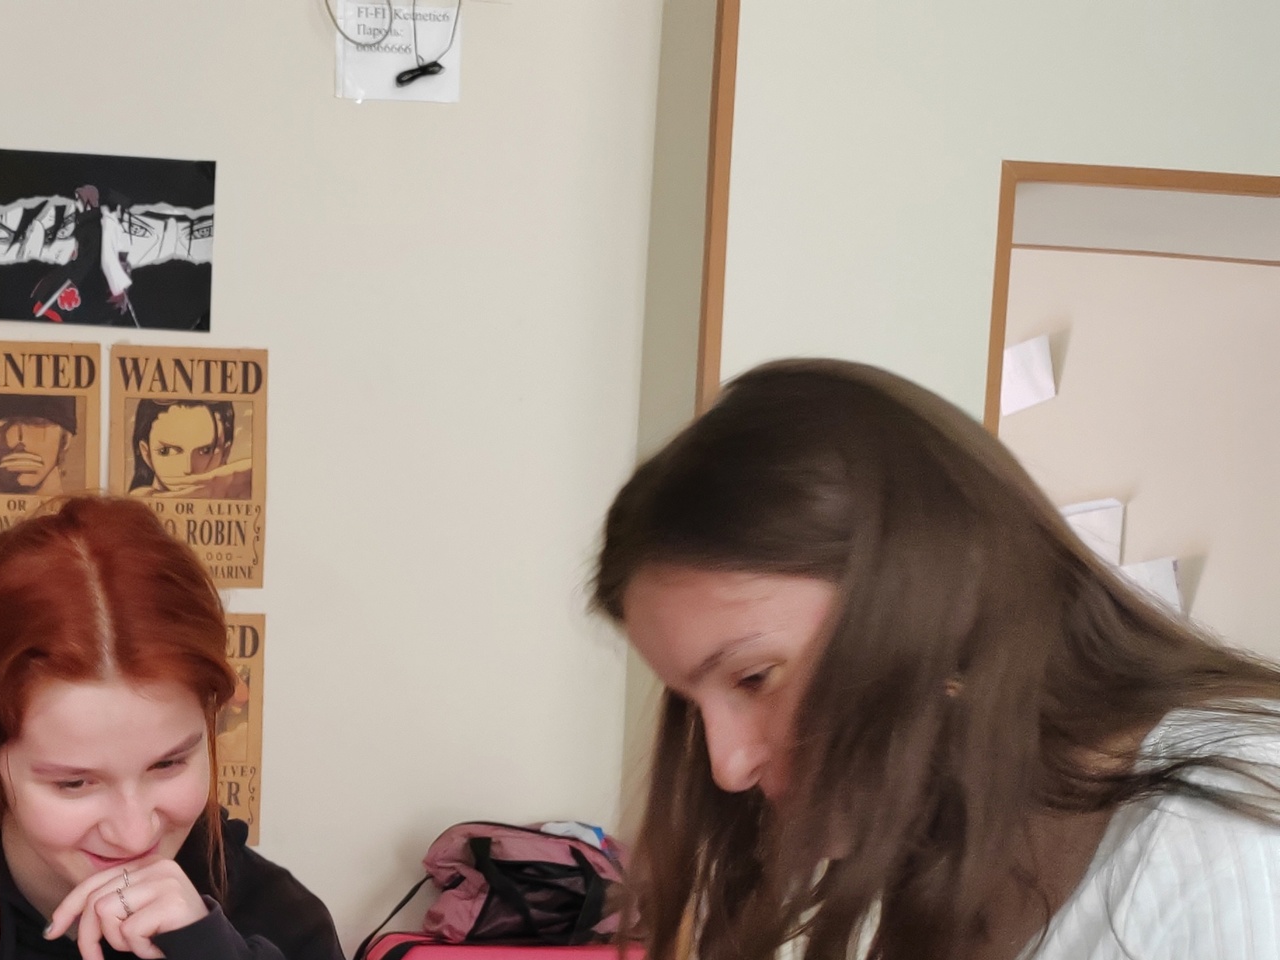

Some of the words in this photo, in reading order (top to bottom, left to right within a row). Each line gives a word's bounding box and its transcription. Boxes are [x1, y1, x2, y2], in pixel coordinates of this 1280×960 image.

[117, 356, 264, 395] WANTED
[6, 499, 26, 511] OR
[175, 503, 194, 515] OR
[206, 503, 253, 516] ALIVE
[186, 519, 247, 547] ROBIN
[210, 566, 253, 580] MARINE
